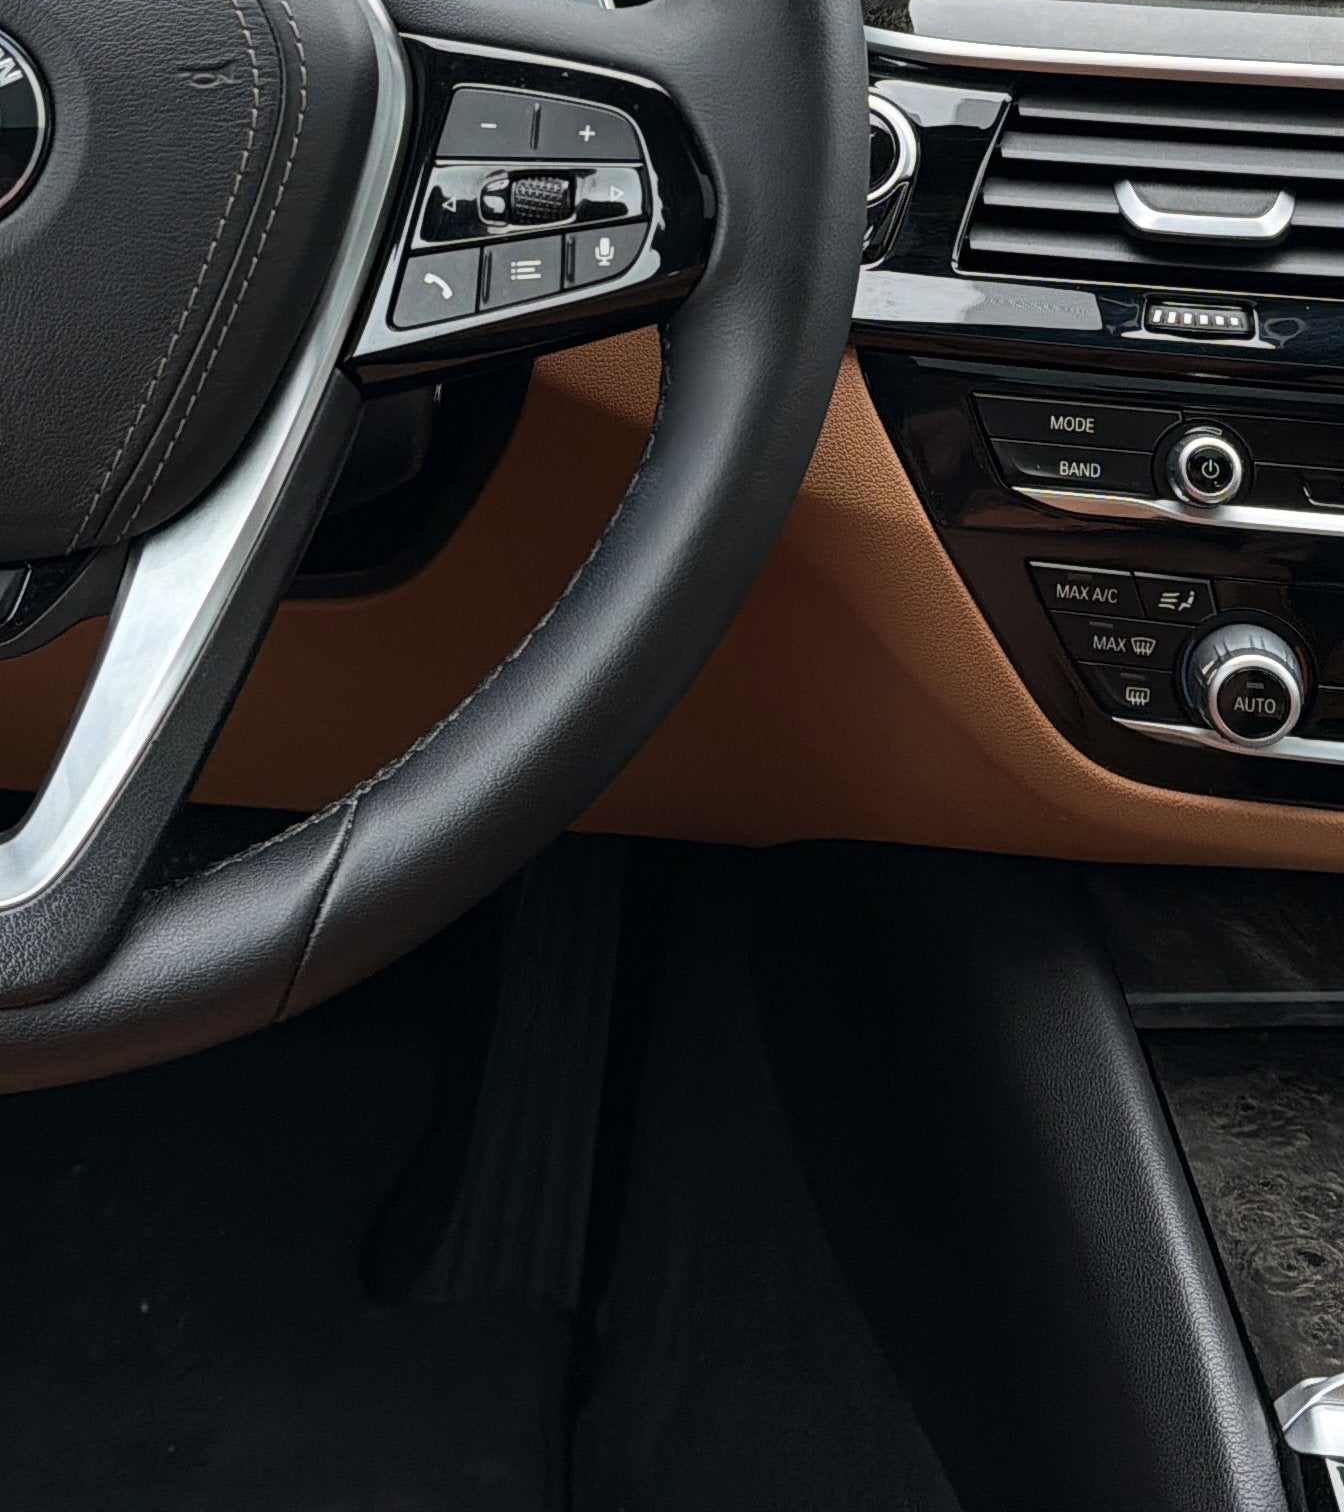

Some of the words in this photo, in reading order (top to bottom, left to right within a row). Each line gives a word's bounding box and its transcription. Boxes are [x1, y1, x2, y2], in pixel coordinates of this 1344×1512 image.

[1049, 415, 1096, 434] MODE
[1059, 460, 1101, 478] BAND
[1056, 583, 1089, 601] MAX
[1091, 587, 1118, 604] A/C
[1092, 635, 1127, 653] MAX
[1233, 696, 1277, 714] AUTO
